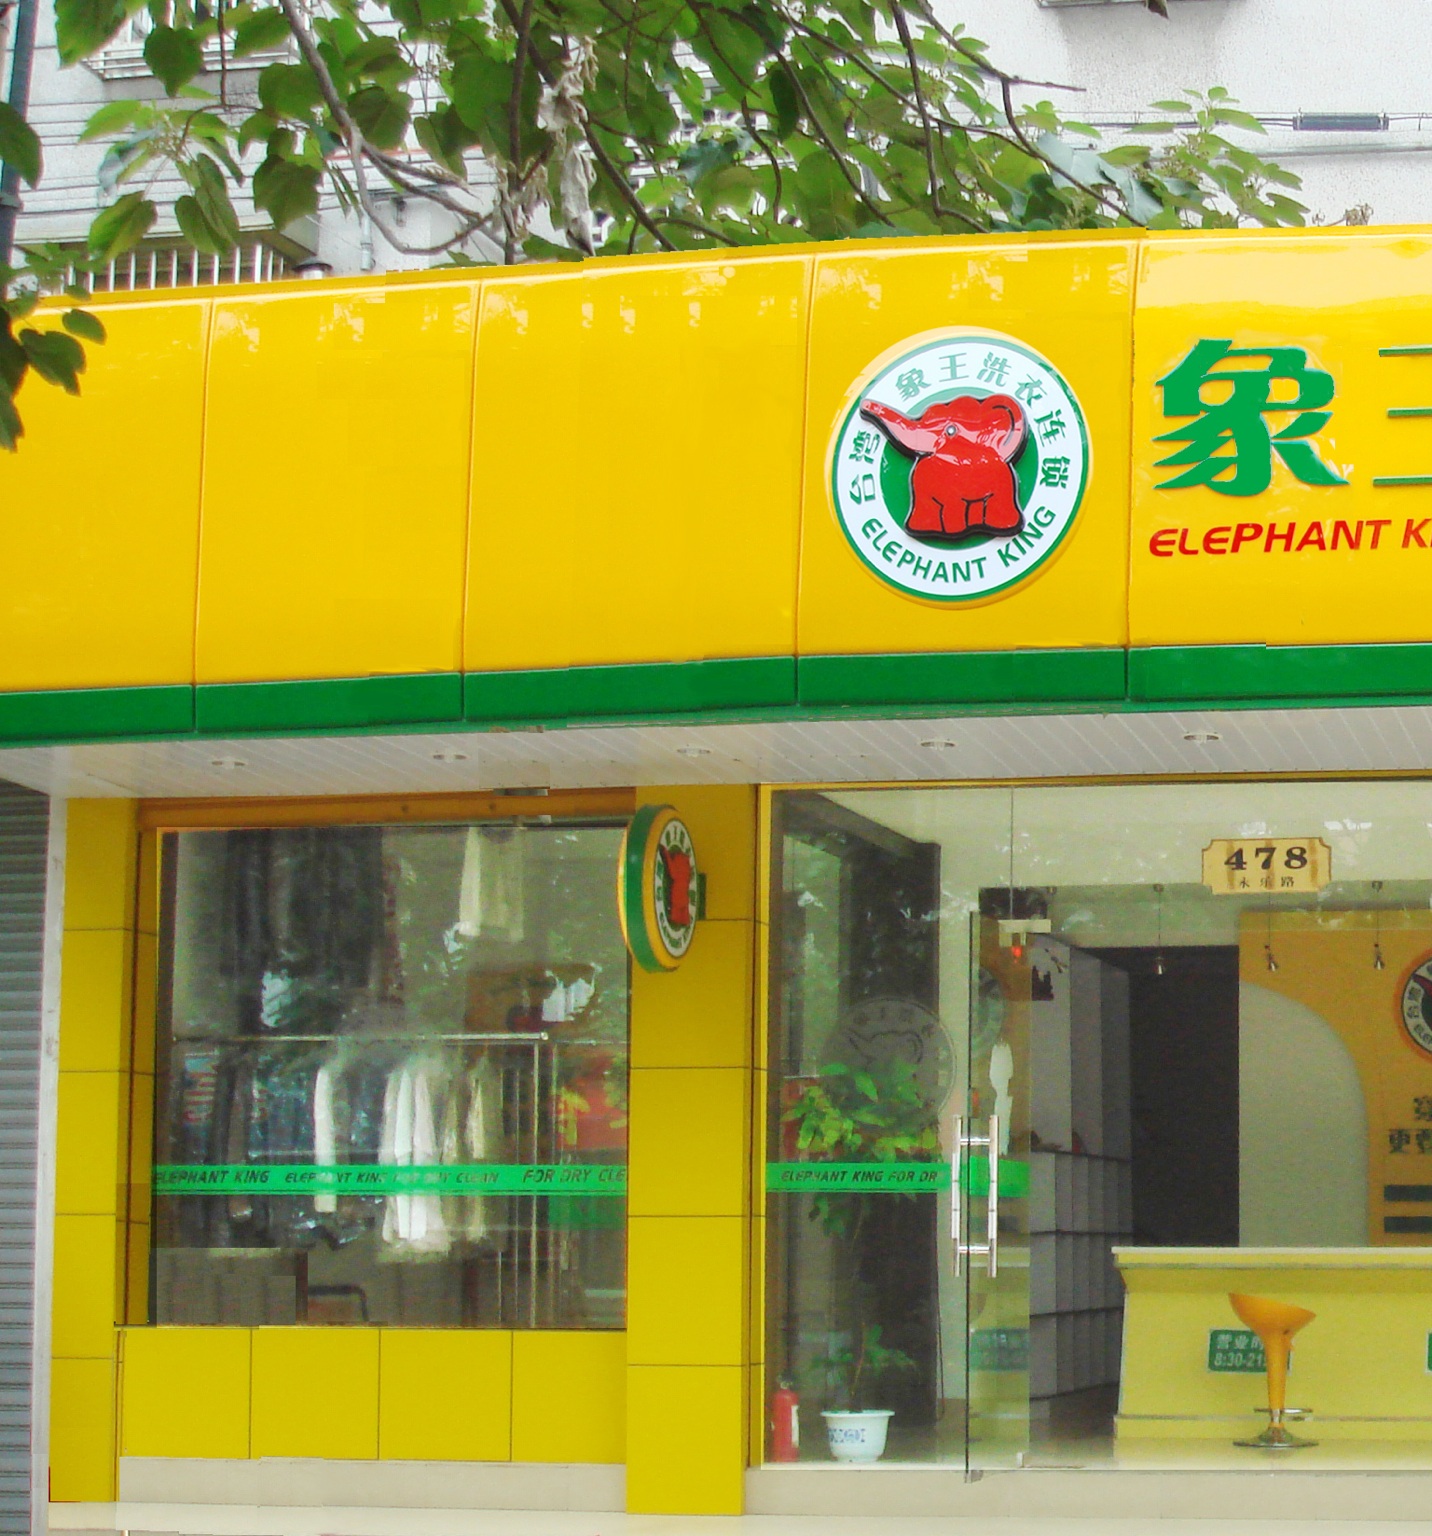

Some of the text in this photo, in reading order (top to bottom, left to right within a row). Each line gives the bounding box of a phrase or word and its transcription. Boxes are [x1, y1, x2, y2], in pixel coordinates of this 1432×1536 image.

[861, 506, 1056, 583] ELEPHANT KING
[1149, 520, 1392, 558] ELEPHANT
[1224, 846, 1308, 871] 478
[234, 1170, 270, 1184] KING
[523, 1168, 555, 1183] FOR
[559, 1168, 593, 1183] DRY
[852, 1170, 883, 1182] KING
[888, 1170, 915, 1182] FOR
